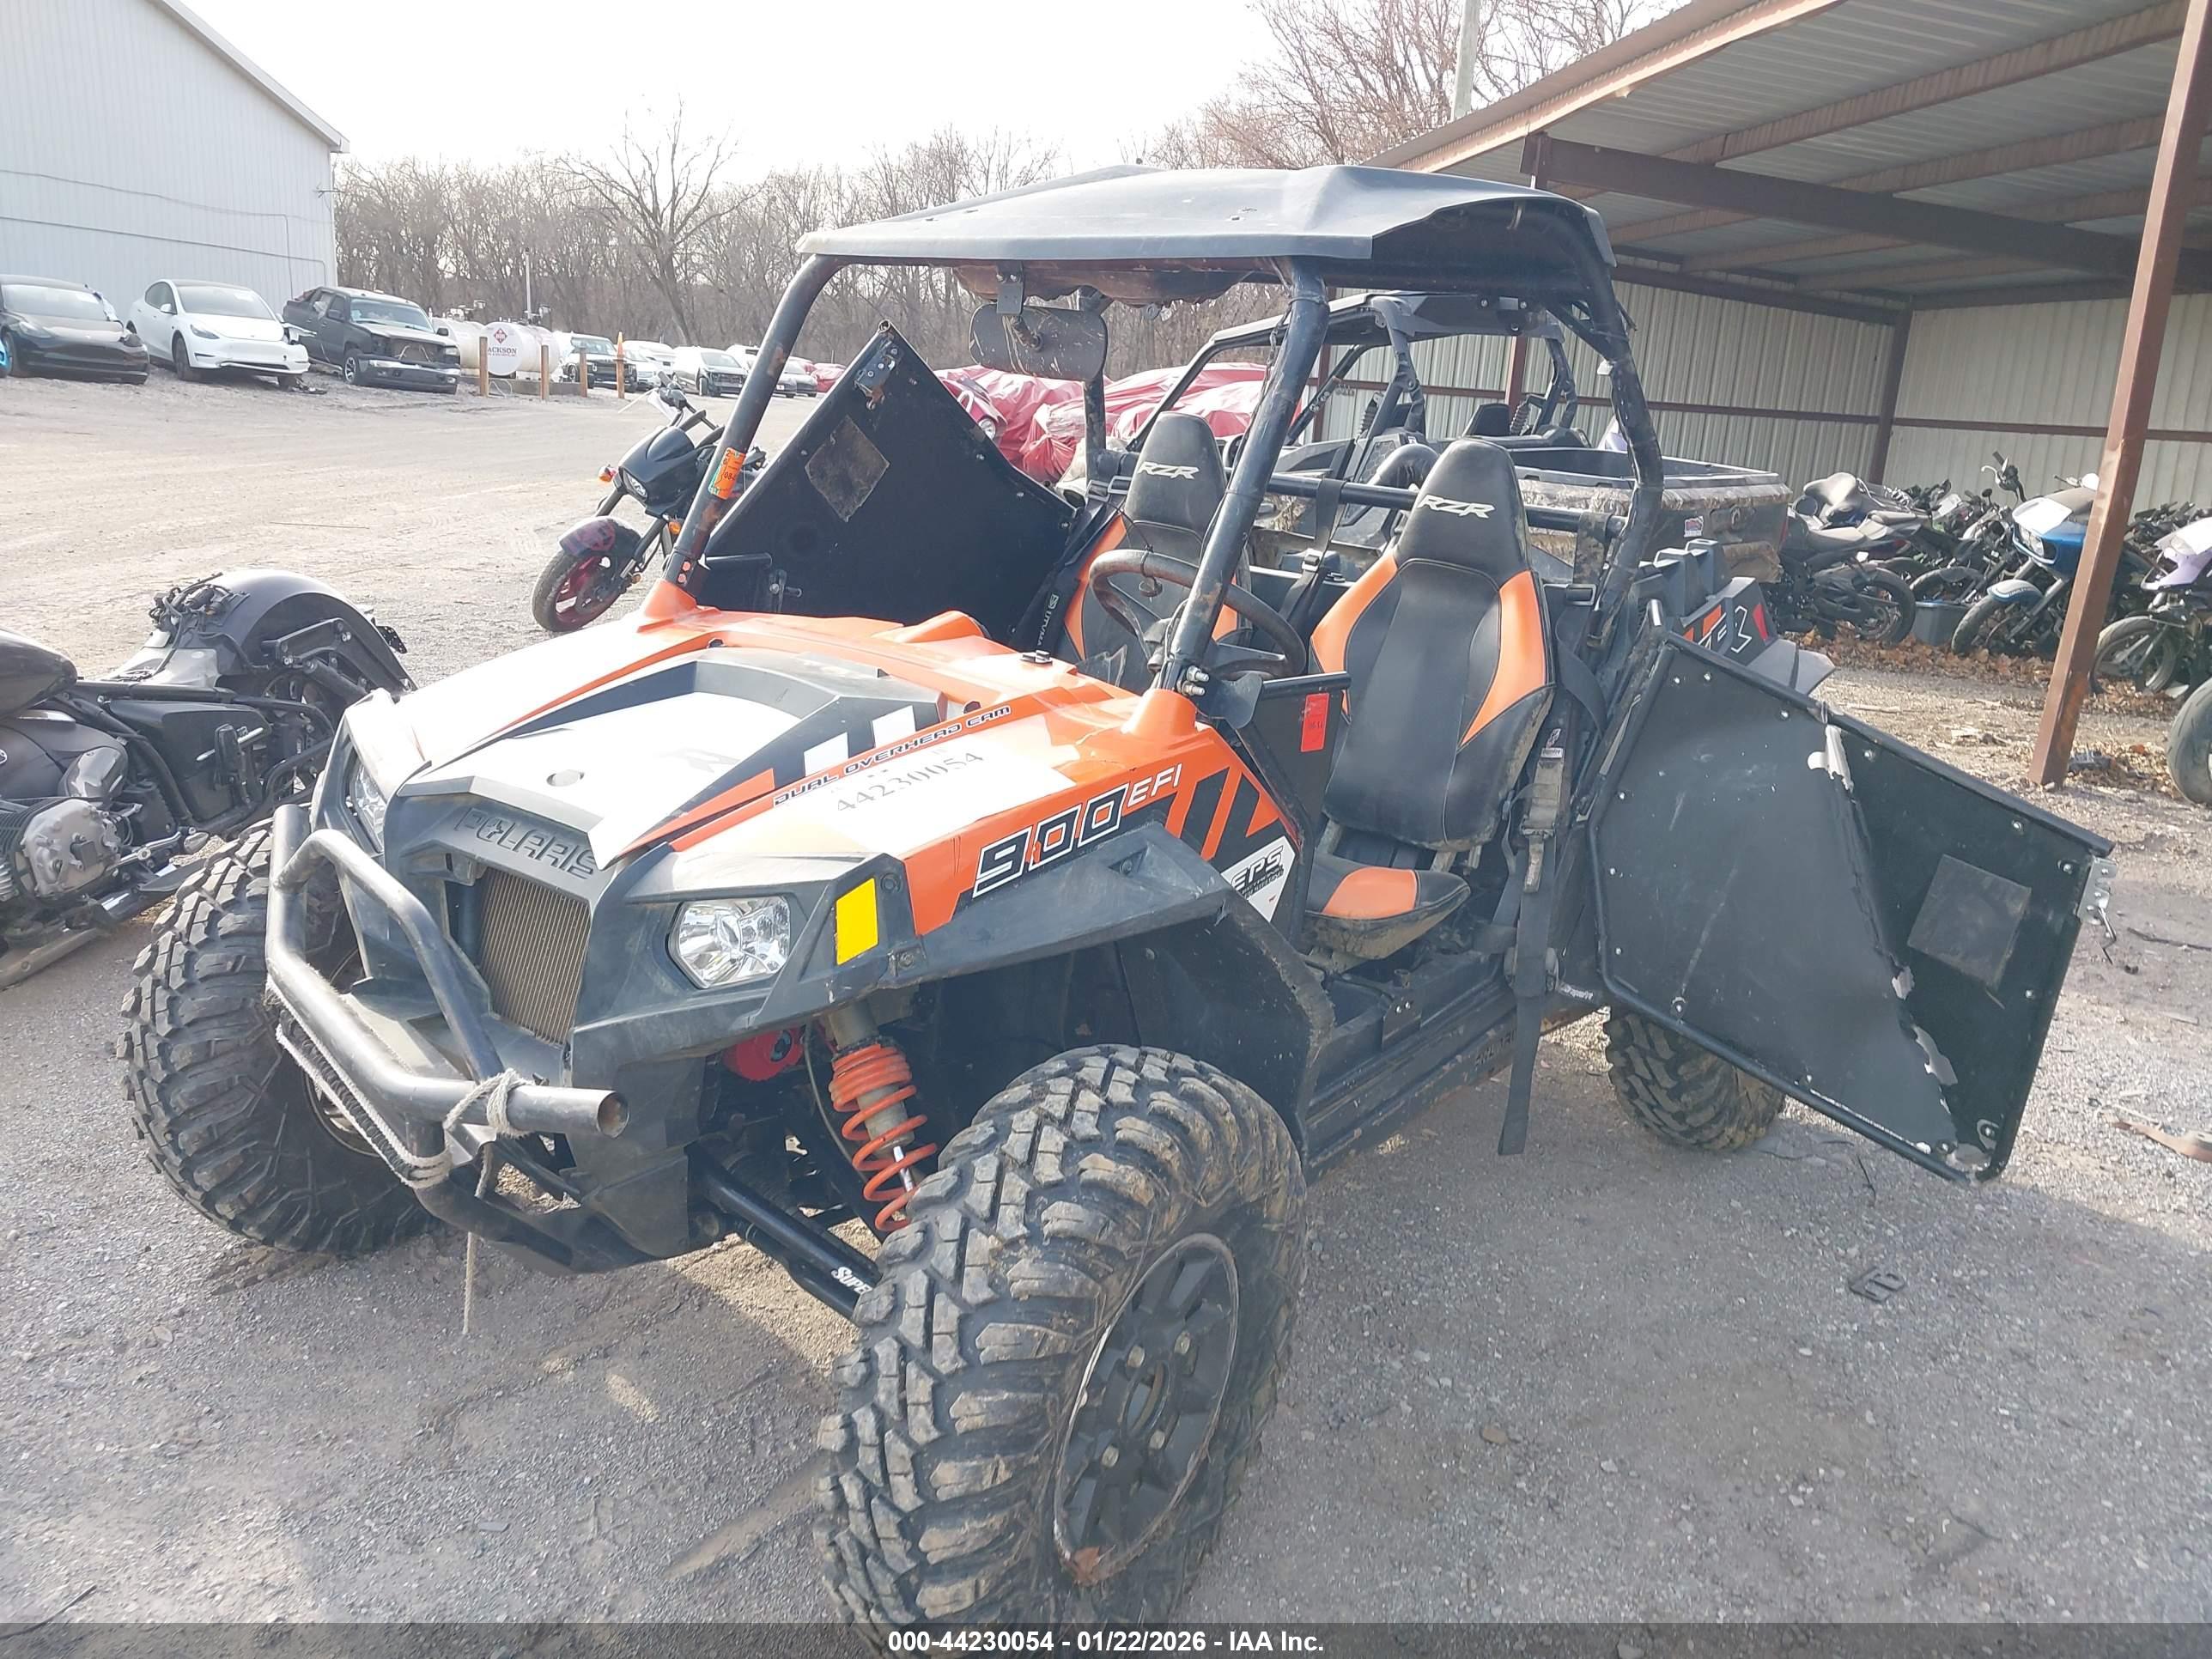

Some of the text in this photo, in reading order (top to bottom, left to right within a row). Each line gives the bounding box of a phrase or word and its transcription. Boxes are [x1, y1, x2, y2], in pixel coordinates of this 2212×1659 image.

[1137, 461, 1200, 480] RZR
[1416, 494, 1495, 519] RZR
[774, 705, 1012, 807] DUAL OVERHEAD CAM
[454, 806, 596, 880] POLARIS
[972, 763, 1183, 899] 900 EFI
[1231, 844, 1285, 892] EPS
